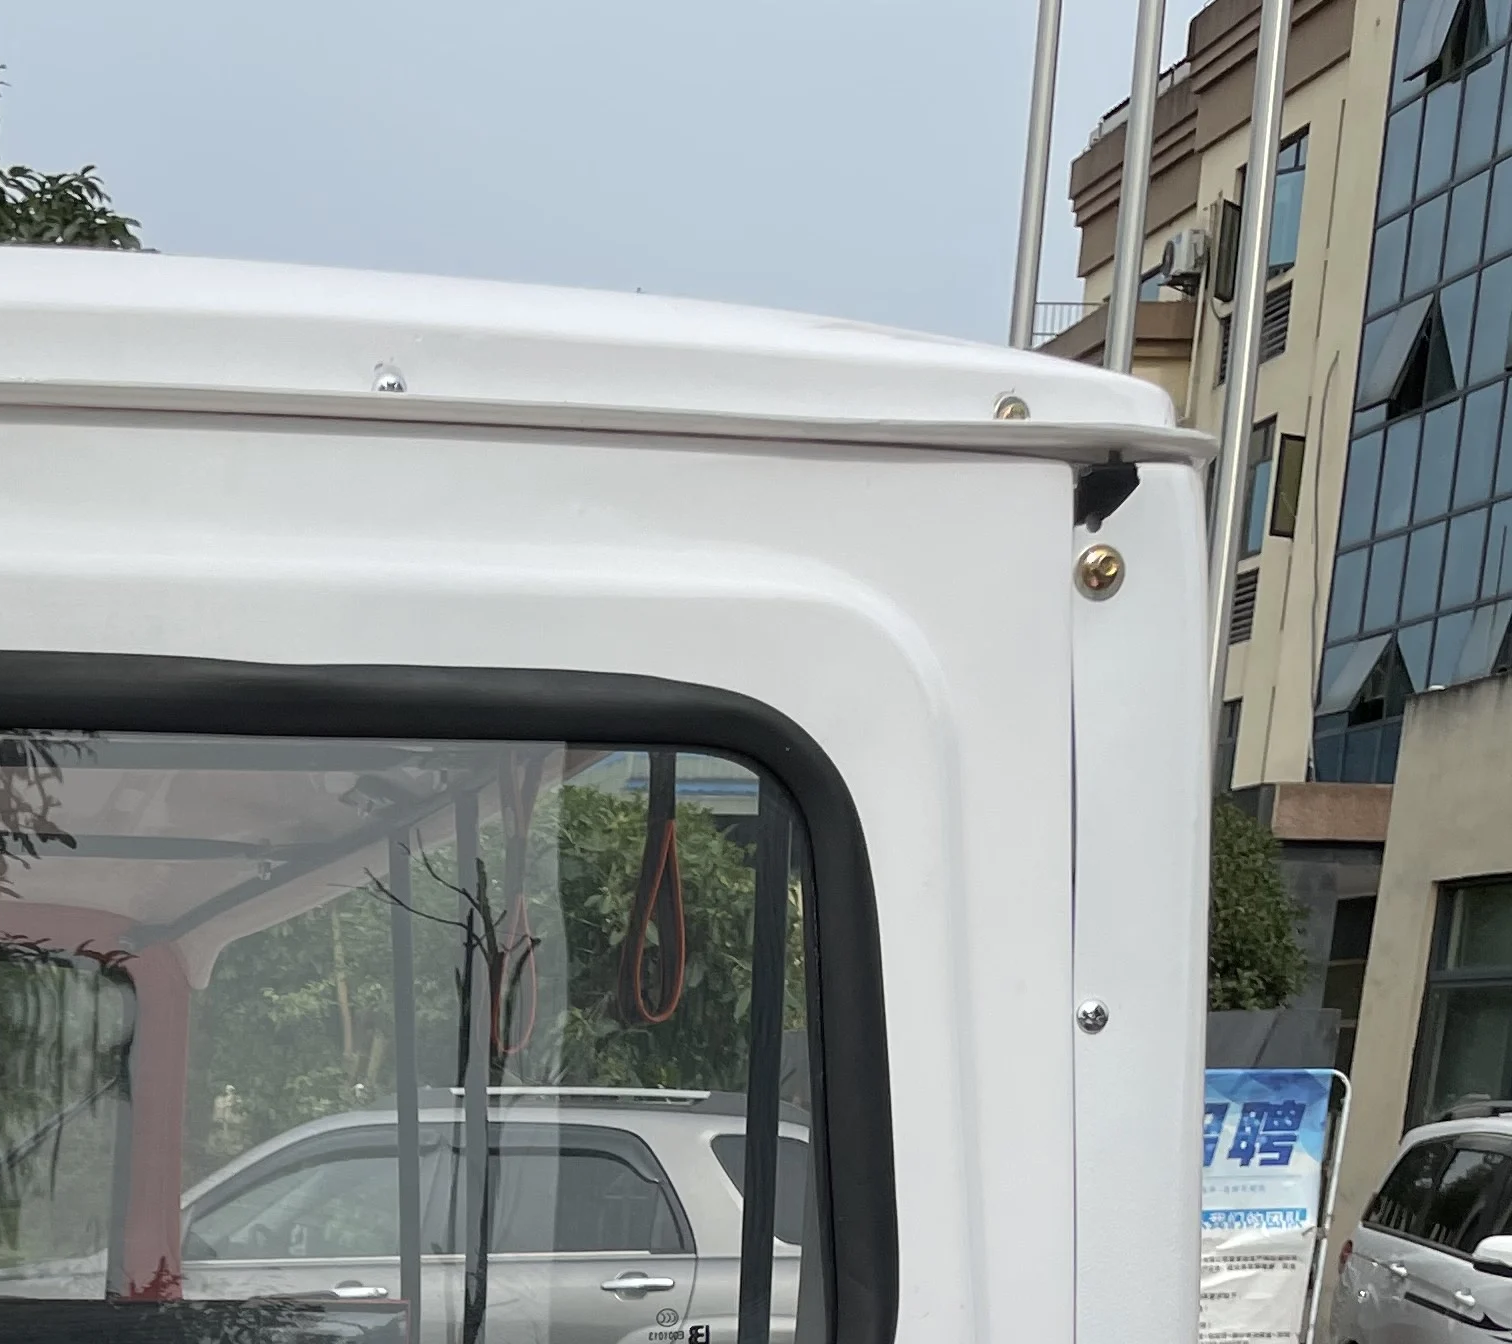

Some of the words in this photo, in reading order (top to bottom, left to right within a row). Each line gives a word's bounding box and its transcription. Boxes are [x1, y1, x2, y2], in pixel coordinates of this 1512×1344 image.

[1202, 1210, 1304, 1230] 我们的团队
